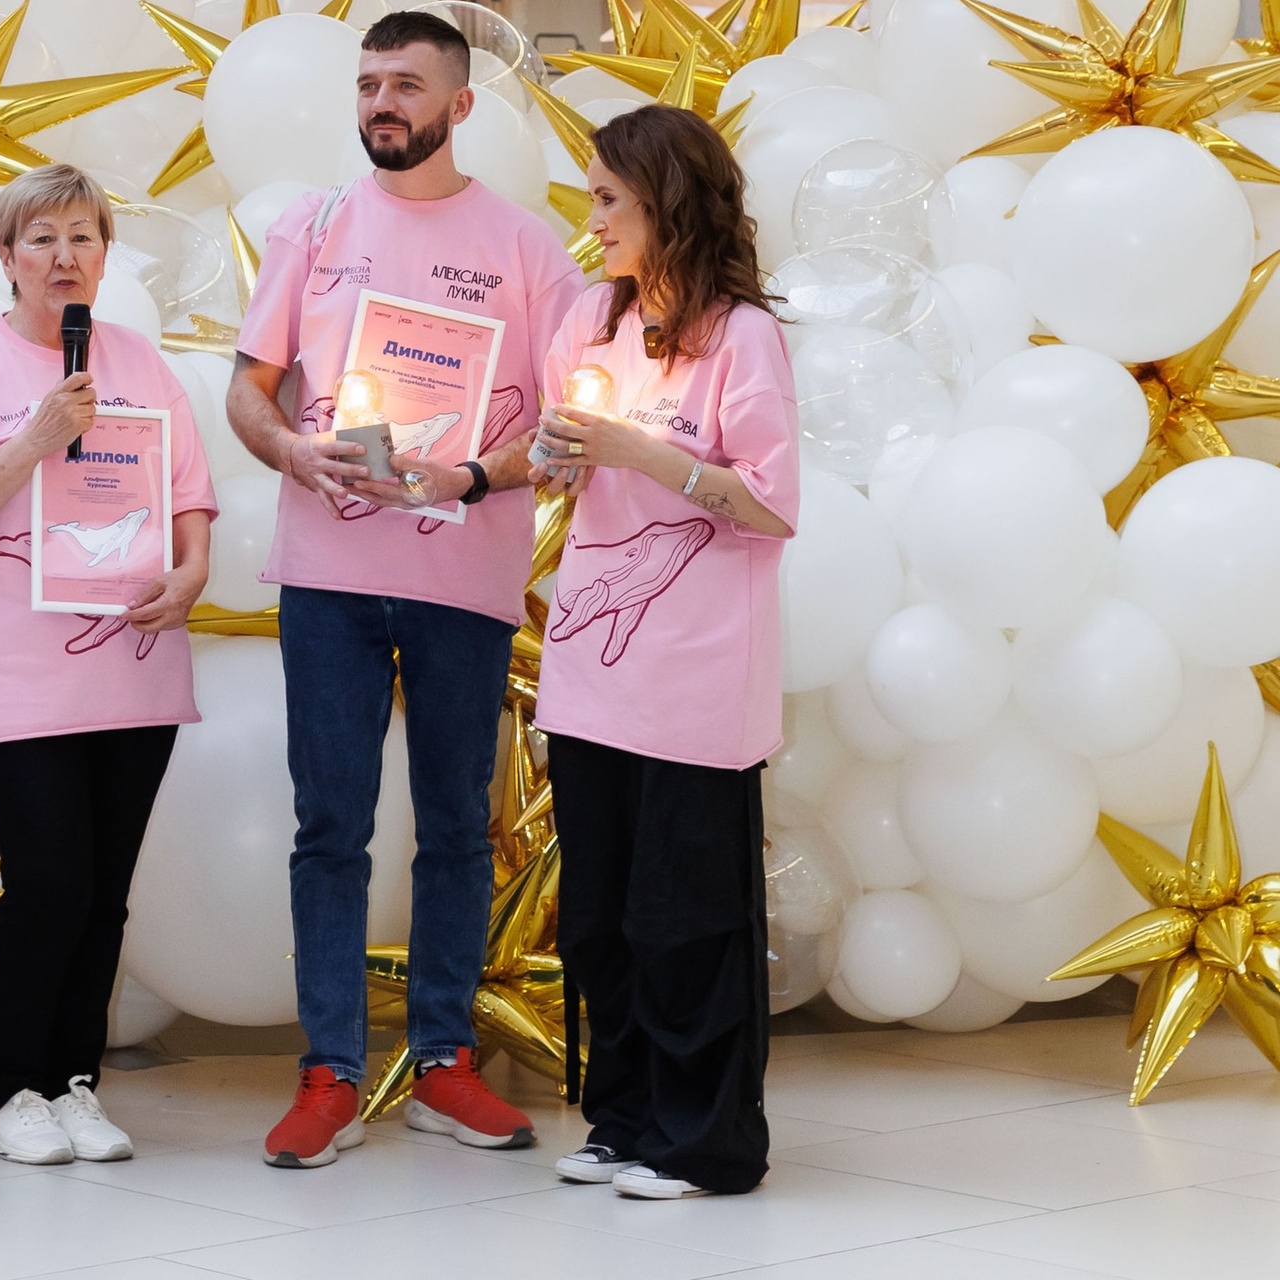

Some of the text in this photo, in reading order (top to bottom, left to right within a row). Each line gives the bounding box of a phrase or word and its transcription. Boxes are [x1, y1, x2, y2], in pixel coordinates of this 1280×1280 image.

[313, 265, 371, 275] УМНАЯ ВЕСНА
[431, 265, 503, 289] АЛЕКСАНДР
[347, 274, 371, 284] 2025
[446, 285, 486, 303] ЛУКИН
[382, 340, 462, 369] Диплом
[654, 397, 680, 411] ДИНА
